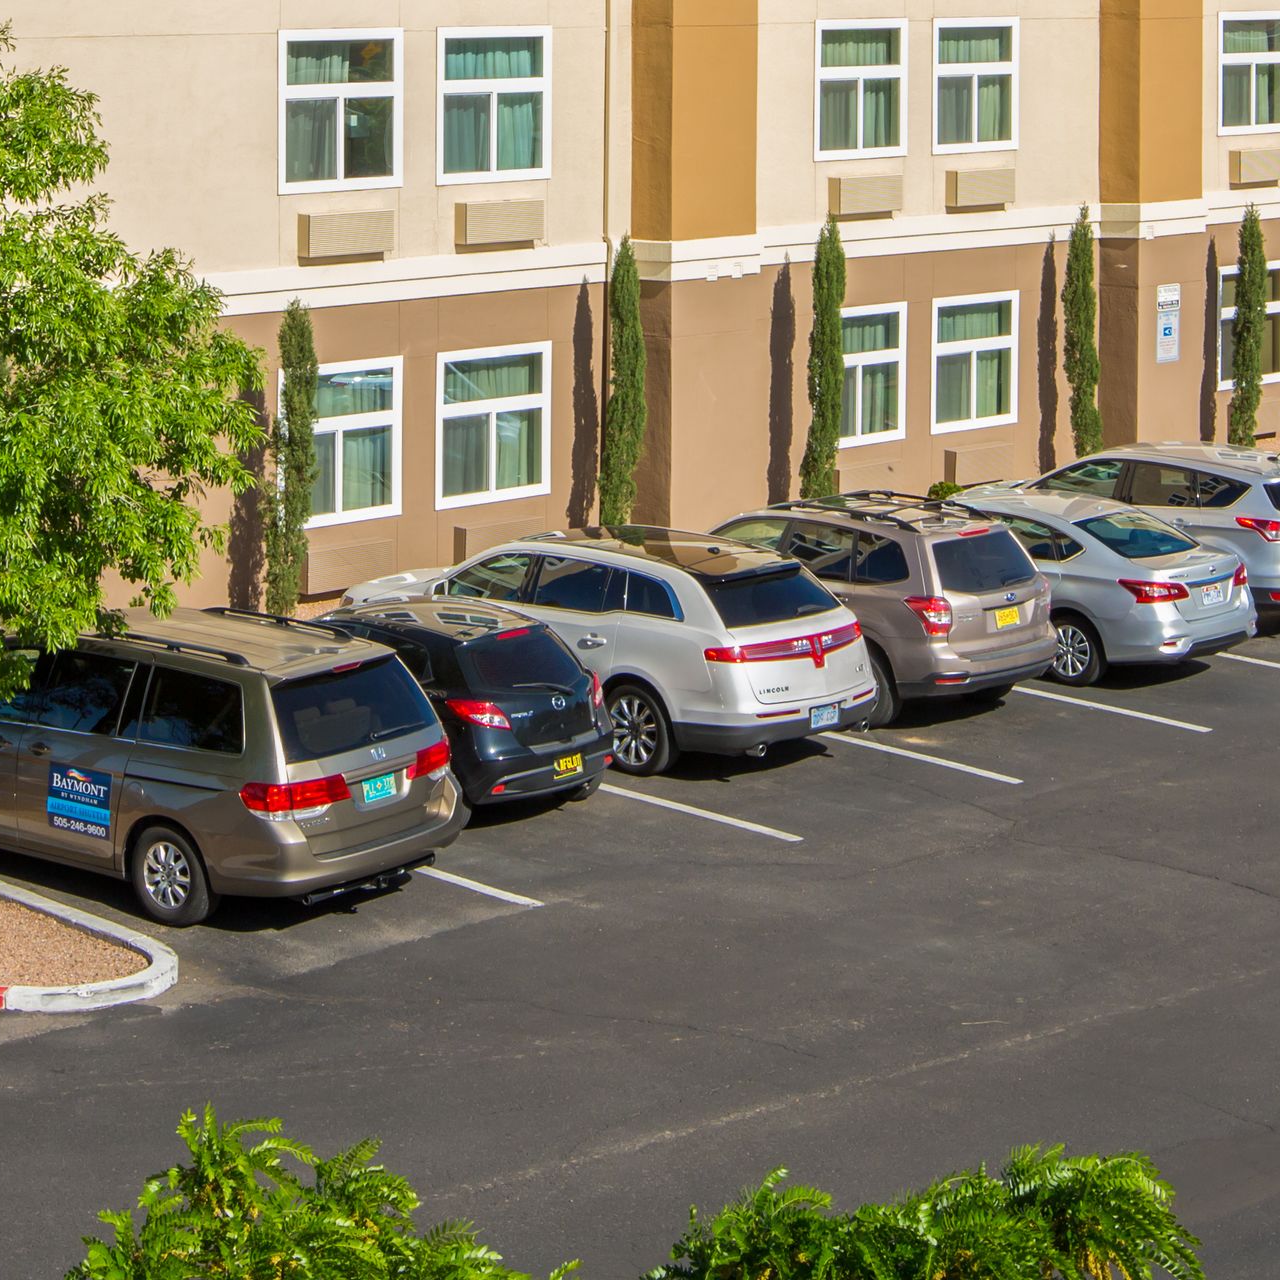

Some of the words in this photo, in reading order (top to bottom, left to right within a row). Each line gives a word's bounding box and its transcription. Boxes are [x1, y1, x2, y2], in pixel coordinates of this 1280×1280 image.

[759, 686, 789, 695] LINCOLN
[53, 773, 107, 797] BAYMONT
[61, 791, 68, 799] BY
[70, 793, 98, 805] WYNDHAM
[53, 816, 106, 837] 505-246-9600
